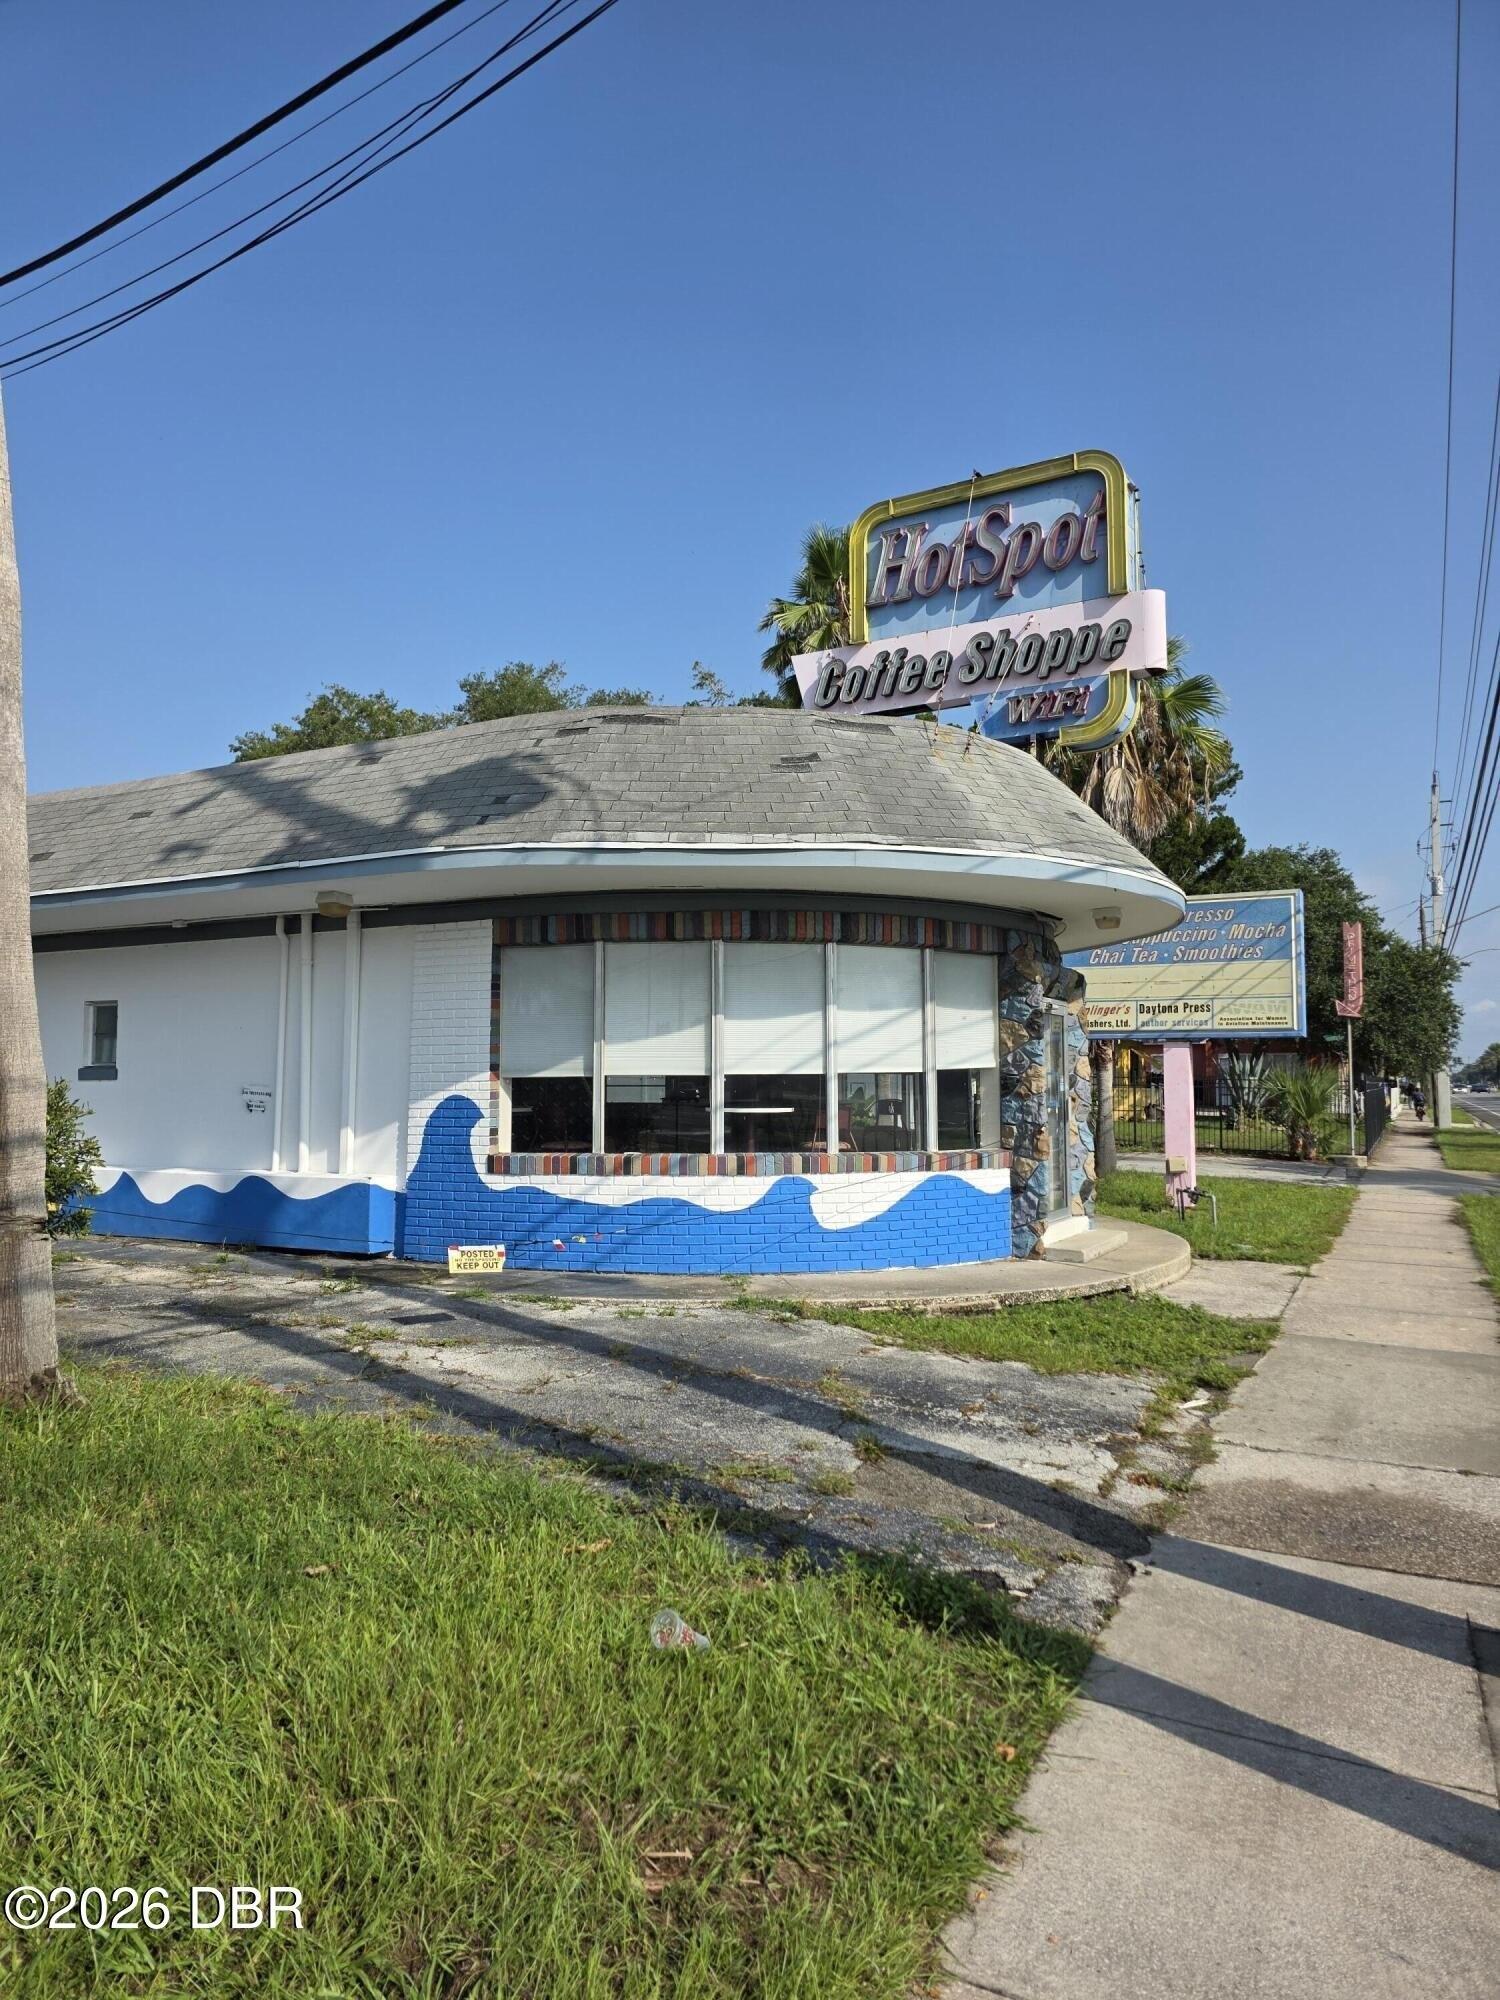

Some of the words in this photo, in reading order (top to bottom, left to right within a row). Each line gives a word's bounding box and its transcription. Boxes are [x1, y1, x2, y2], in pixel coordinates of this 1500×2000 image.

[864, 489, 1107, 608] HotSpot
[813, 646, 953, 709] Coffee
[957, 617, 1133, 685] Shoppe
[1006, 684, 1091, 725] WiFi
[1183, 908, 1235, 923] resso
[1228, 922, 1287, 940] Mocha
[1089, 948, 1127, 964] Chai
[1131, 946, 1159, 962] Tea
[1173, 943, 1264, 961] Smoothies
[1139, 1003, 1179, 1015] Daytona
[1183, 1002, 1212, 1013] Press
[1115, 1019, 1132, 1028] Ltd.
[1172, 1018, 1209, 1027] services
[460, 1250, 495, 1258] POSTED
[456, 1261, 480, 1270] KEEP
[482, 1261, 500, 1269] OUT
